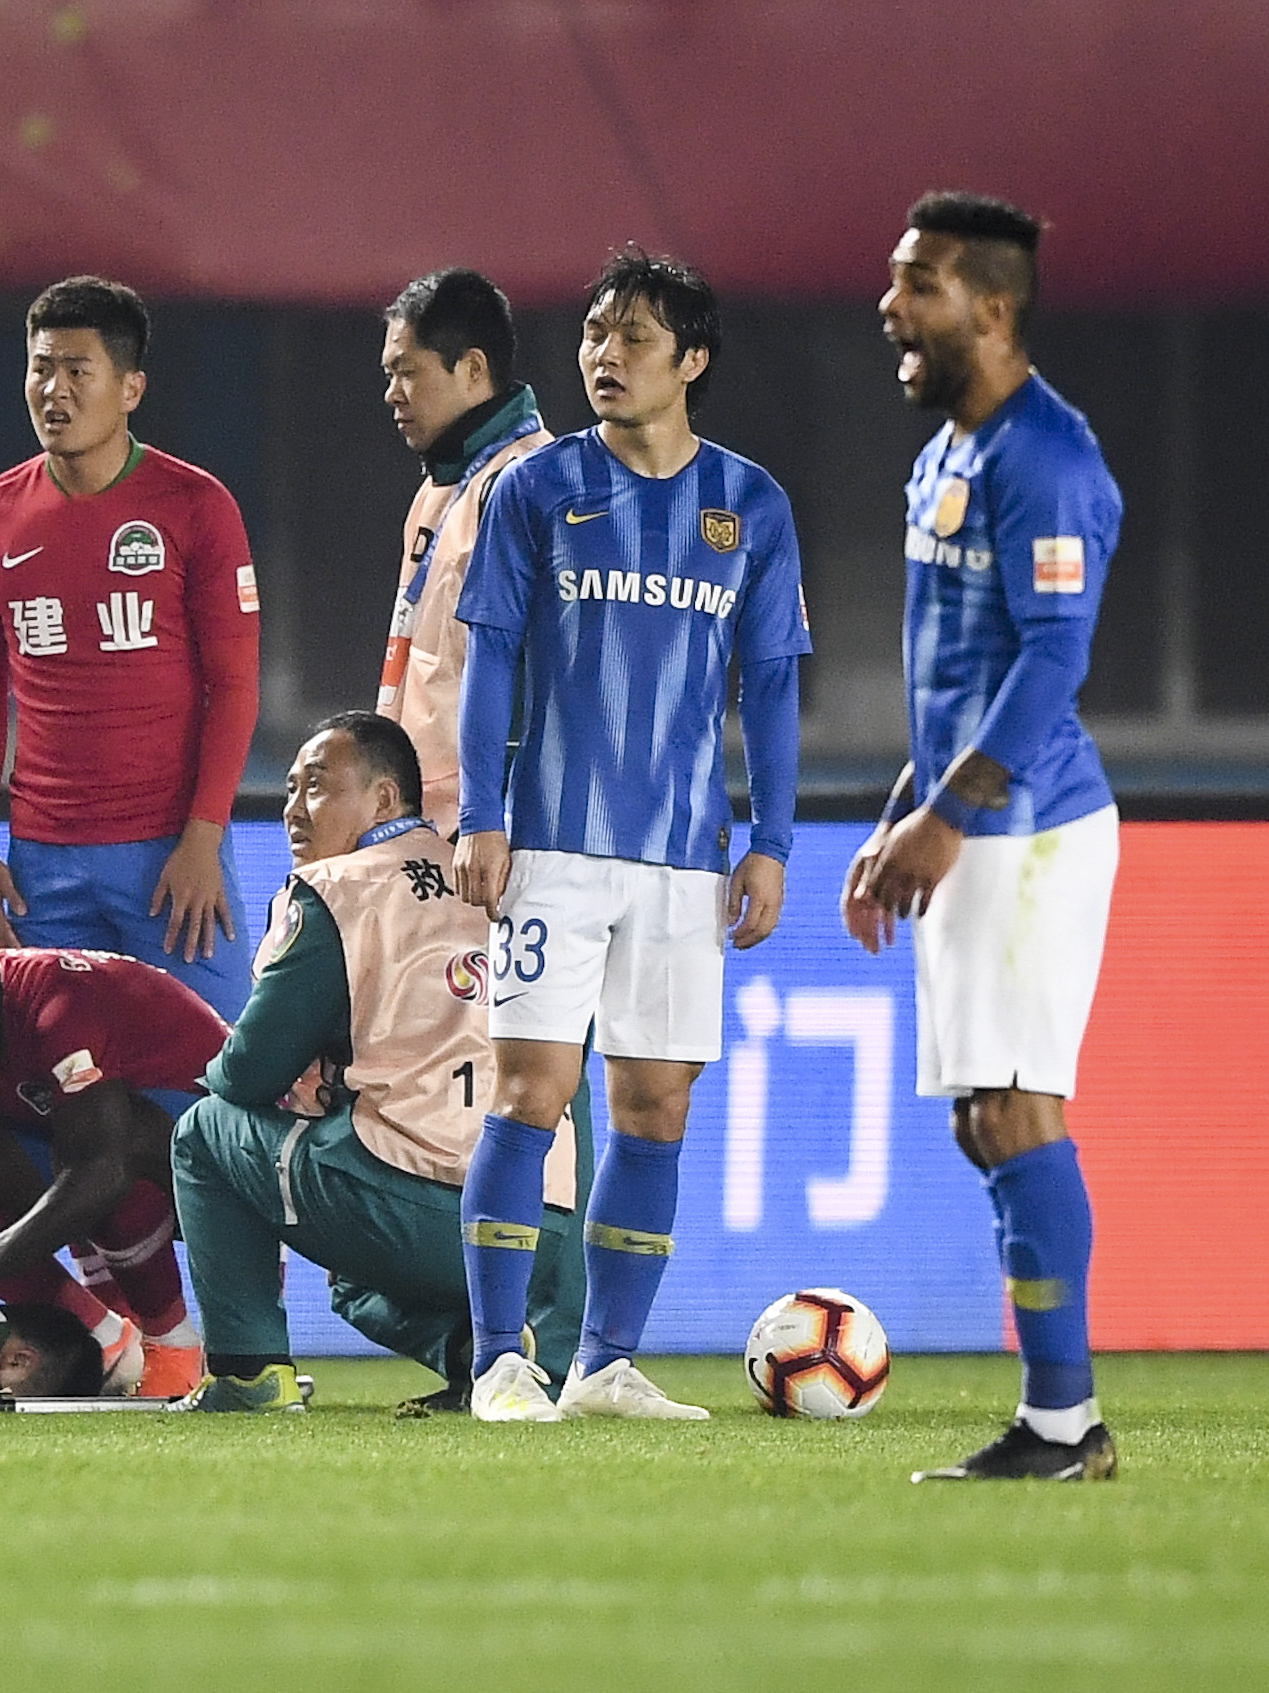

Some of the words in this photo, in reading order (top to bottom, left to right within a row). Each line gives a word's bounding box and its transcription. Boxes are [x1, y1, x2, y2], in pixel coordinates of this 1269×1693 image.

[558, 569, 736, 619] SAMSUNG
[8, 592, 158, 656] 建业
[400, 858, 455, 900] 救
[492, 915, 548, 982] 33
[452, 1061, 474, 1108] 1
[723, 975, 894, 1231] 门
